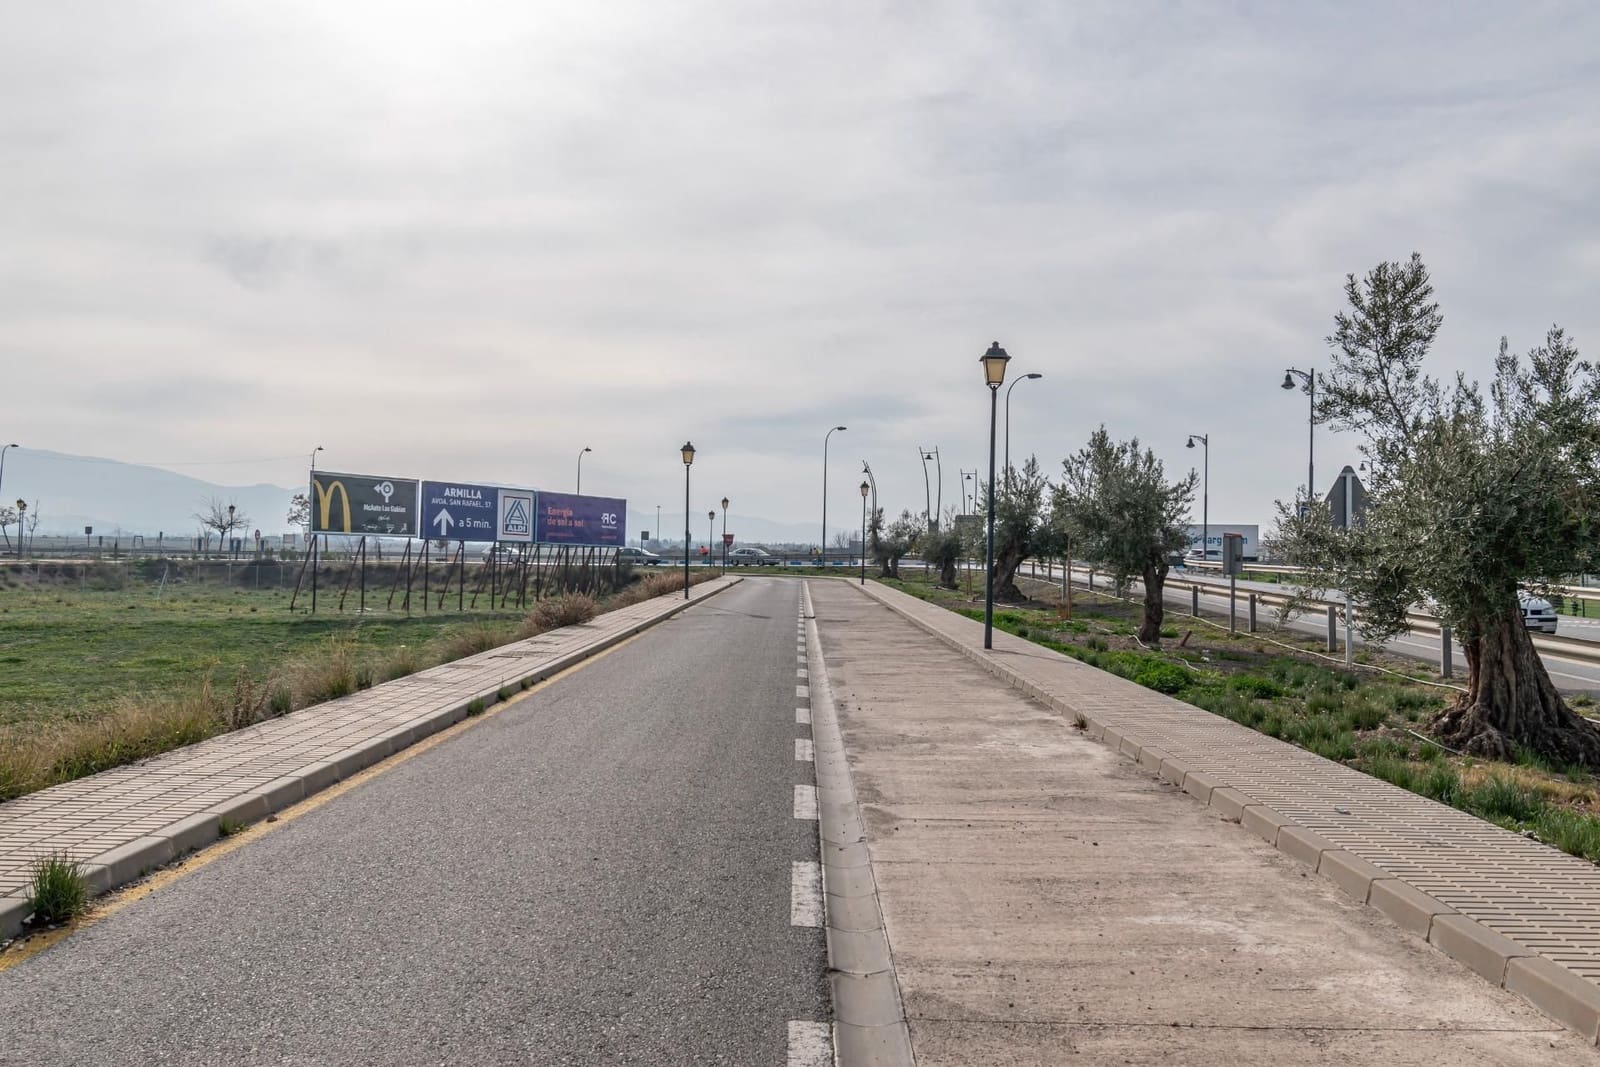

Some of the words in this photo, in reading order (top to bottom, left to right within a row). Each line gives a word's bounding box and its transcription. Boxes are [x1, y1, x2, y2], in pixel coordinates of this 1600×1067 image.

[444, 487, 482, 499] ARMILLA
[449, 498, 462, 506] SAN
[458, 519, 465, 527] a
[466, 517, 472, 528] 5
[473, 518, 492, 529] min.
[574, 519, 584, 527] sol
[507, 524, 527, 532] ALDI
